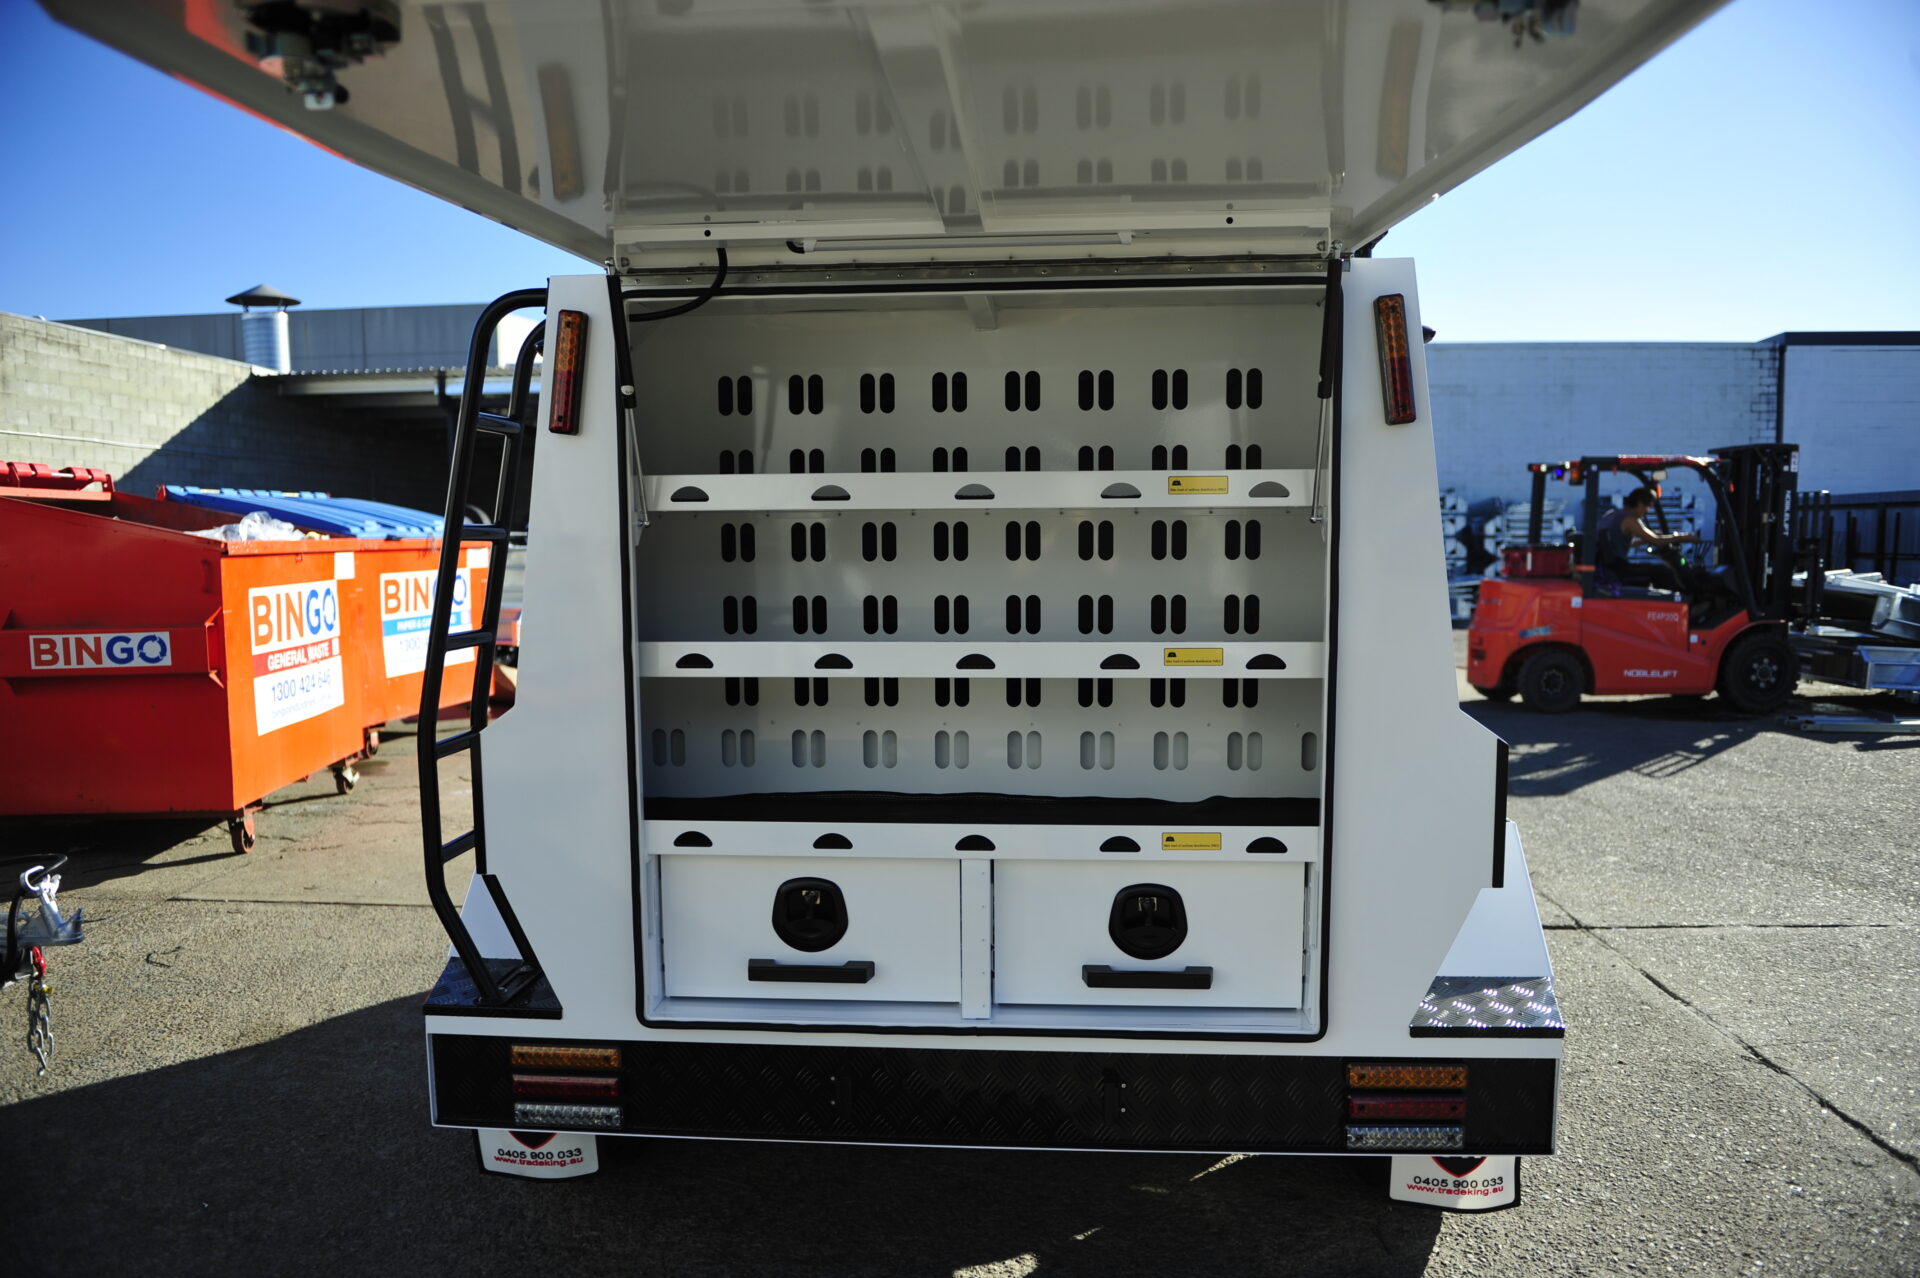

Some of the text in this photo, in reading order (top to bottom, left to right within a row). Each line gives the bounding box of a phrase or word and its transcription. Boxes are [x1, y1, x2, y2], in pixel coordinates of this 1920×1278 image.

[252, 587, 337, 647] BINGO
[33, 634, 168, 667] BINGO
[267, 641, 330, 672] GENERAL WASTE
[1623, 669, 1678, 679] NOBLELIFT
[272, 678, 297, 702] 1300
[299, 673, 316, 693] 424
[497, 1148, 582, 1160] 0405 900 033
[494, 1155, 584, 1167] www.tradeking.au
[1413, 1176, 1503, 1188] 0405 900 033
[1407, 1183, 1504, 1196] www.tradeking.au
